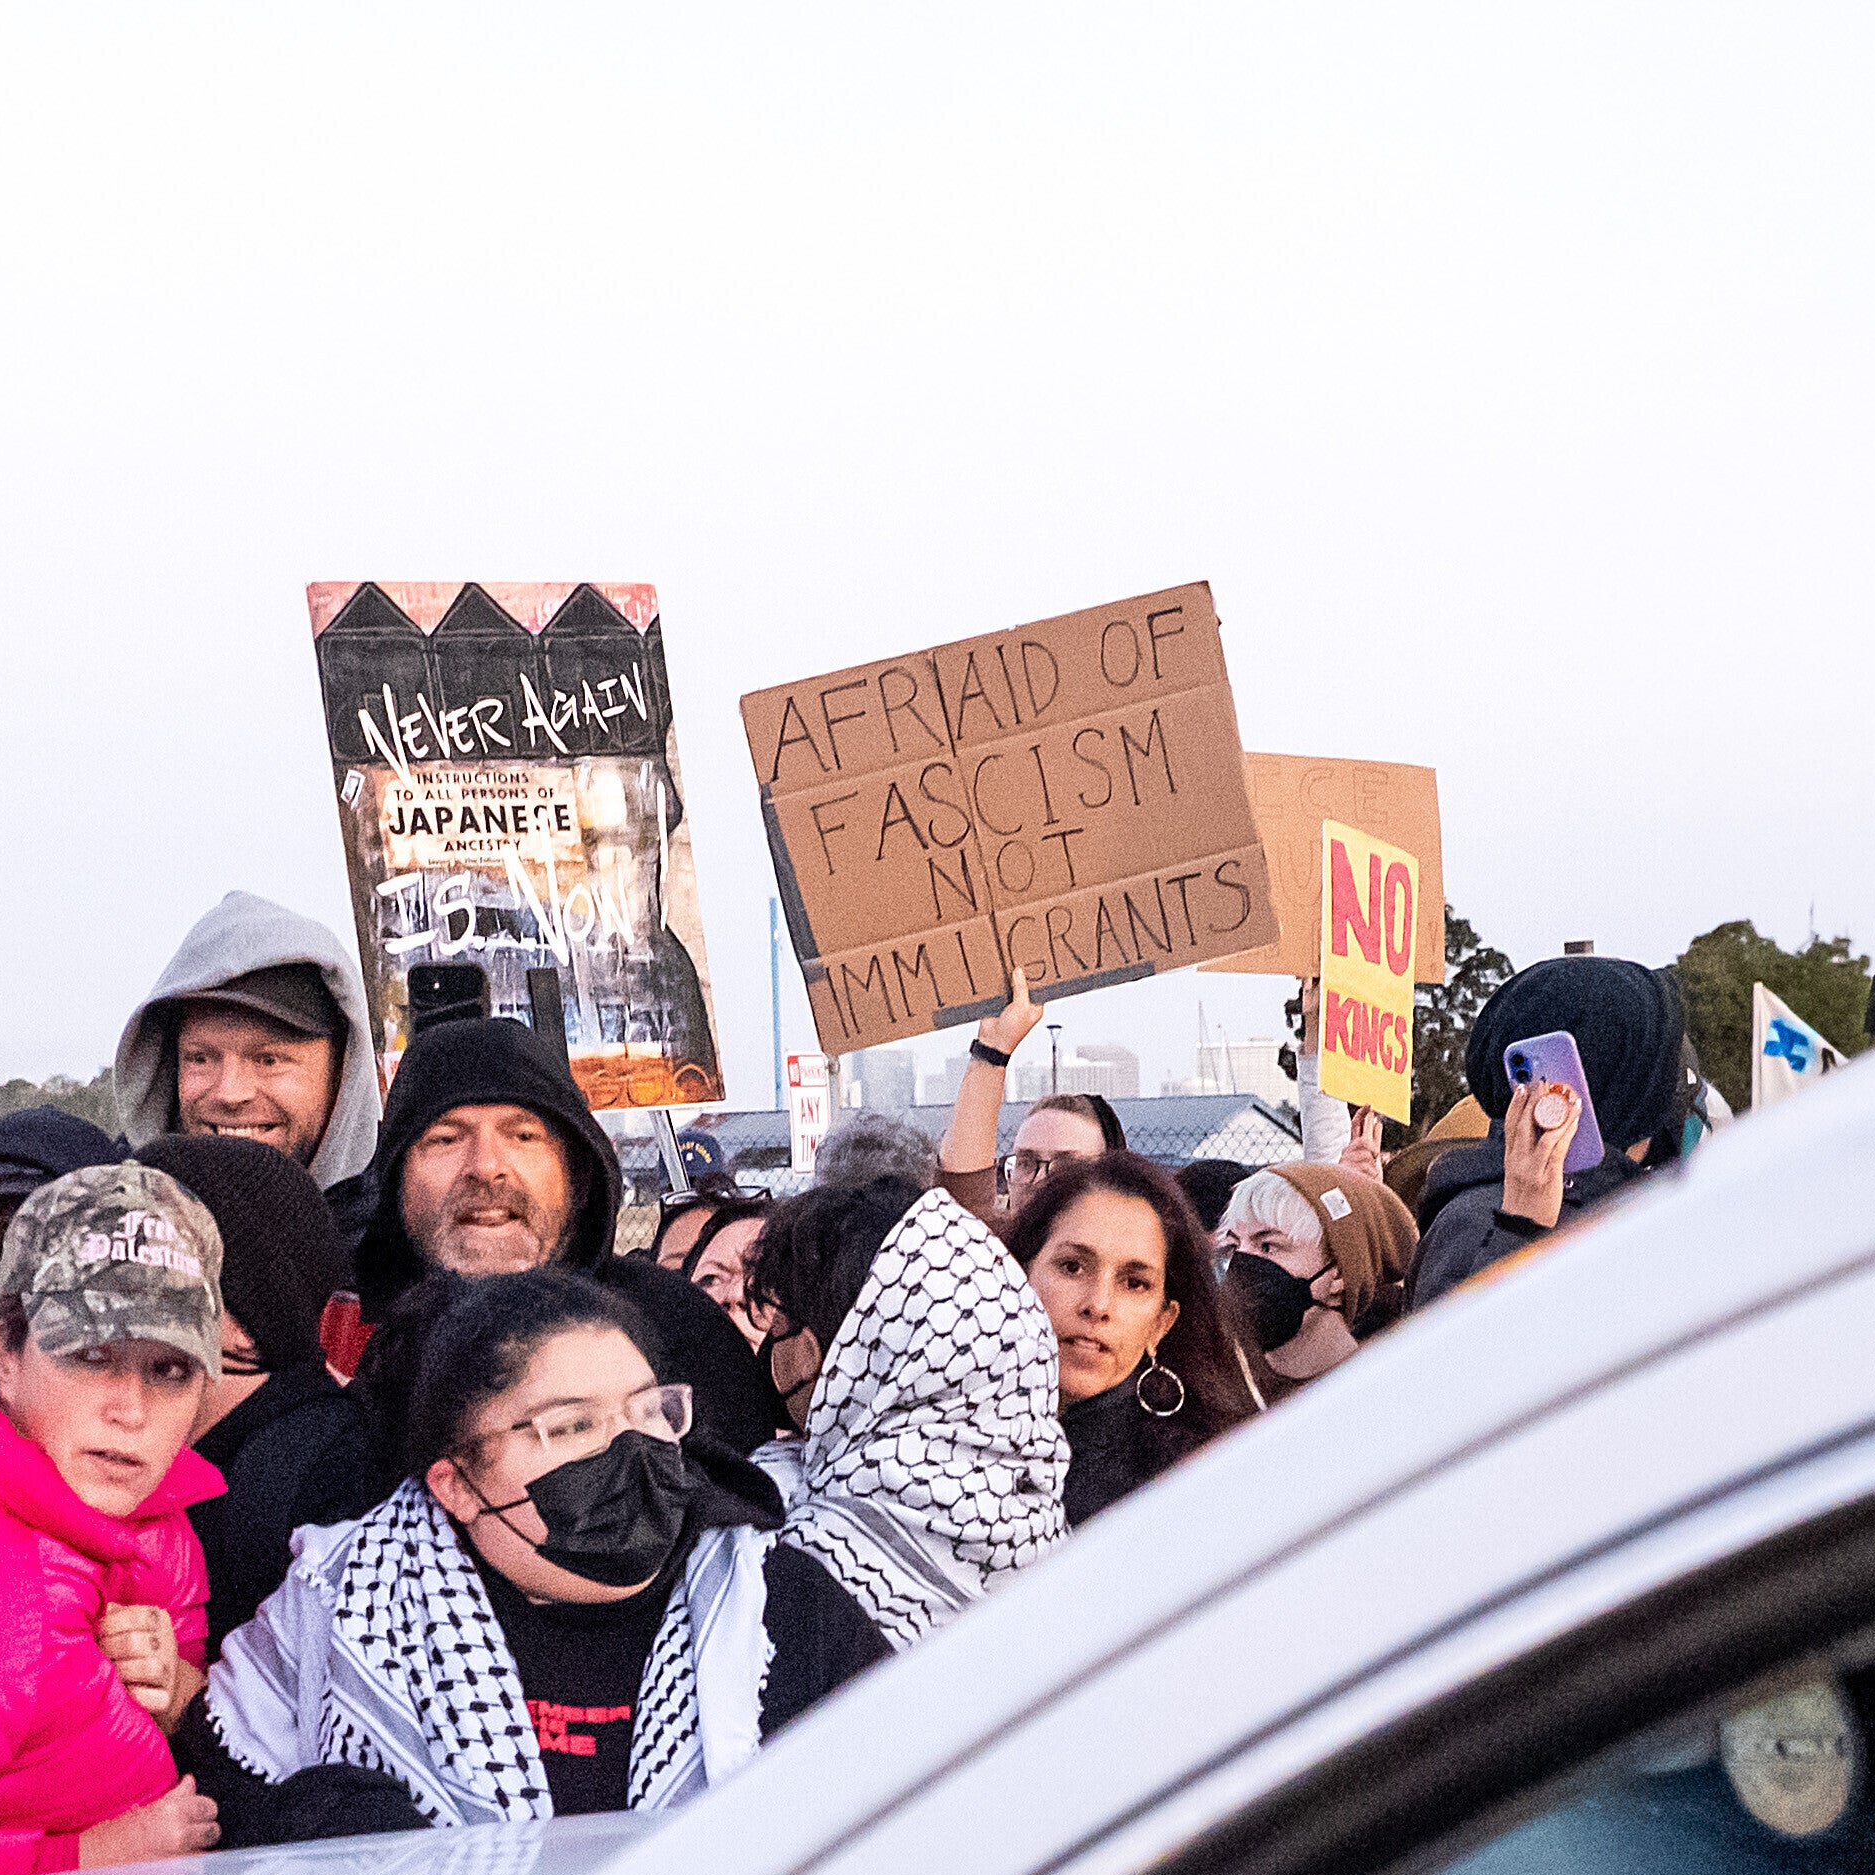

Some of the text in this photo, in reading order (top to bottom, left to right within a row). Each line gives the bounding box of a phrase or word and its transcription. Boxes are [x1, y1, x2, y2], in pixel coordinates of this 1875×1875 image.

[358, 663, 648, 790] NEVER AGAIN
[771, 606, 1185, 782] AFRAID OF
[394, 787, 555, 801] TO ALL PERSONS OF
[416, 772, 529, 785] INSTRUCTIONS
[809, 709, 1178, 876] FASCISM
[376, 871, 479, 956] IS
[927, 827, 1084, 921] NOT
[1330, 838, 1412, 977] NO
[824, 859, 1253, 1039] IMMIGRANTS
[1326, 993, 1409, 1077] KINGS
[800, 1096, 821, 1125] ANY
[800, 1134, 824, 1163] TIM
[79, 1233, 201, 1277] Palestine
[113, 1210, 176, 1241] Free
